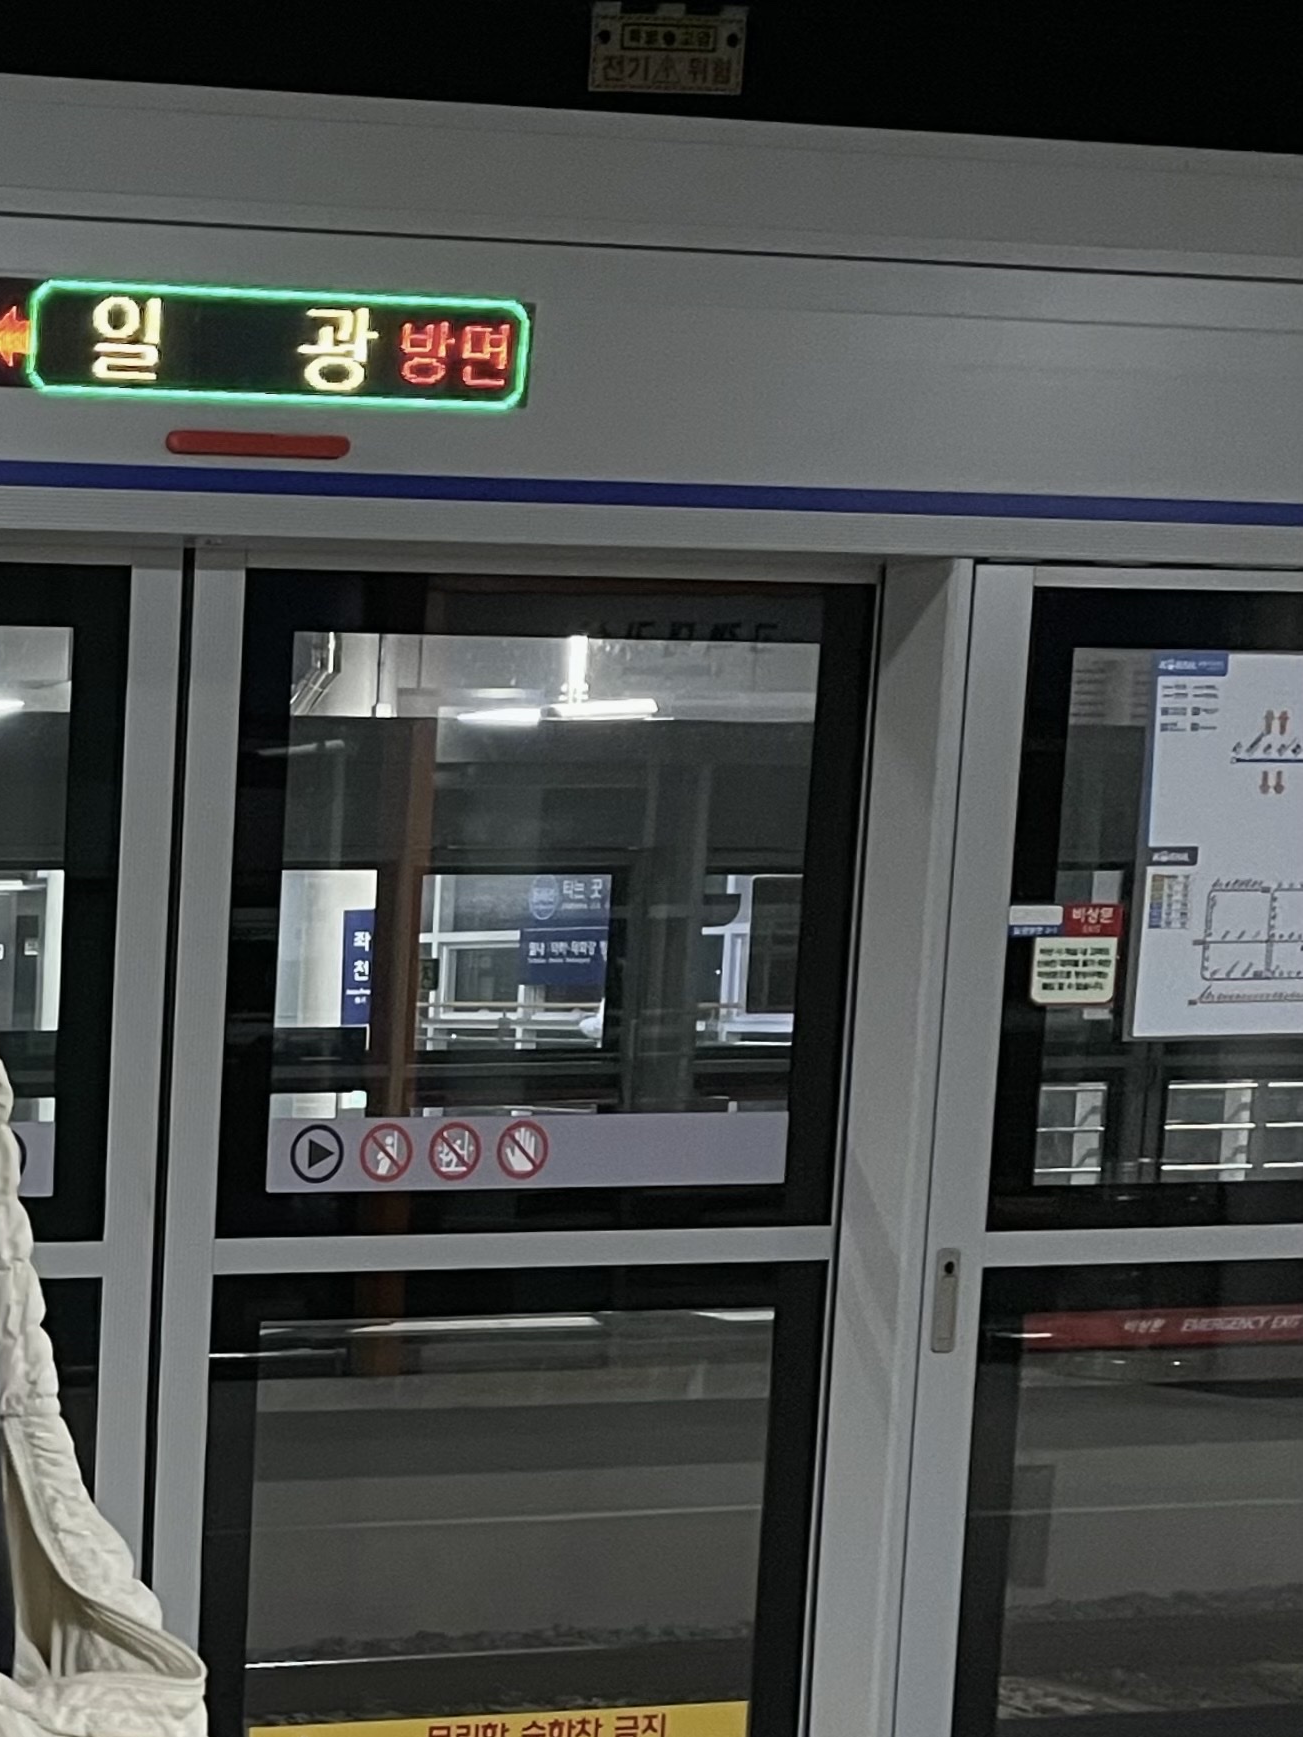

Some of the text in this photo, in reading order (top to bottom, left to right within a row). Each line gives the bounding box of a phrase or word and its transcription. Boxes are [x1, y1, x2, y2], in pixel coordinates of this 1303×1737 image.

[602, 55, 732, 84] 전기 위험
[400, 321, 515, 390] 방면
[1072, 906, 1114, 924] 비상문
